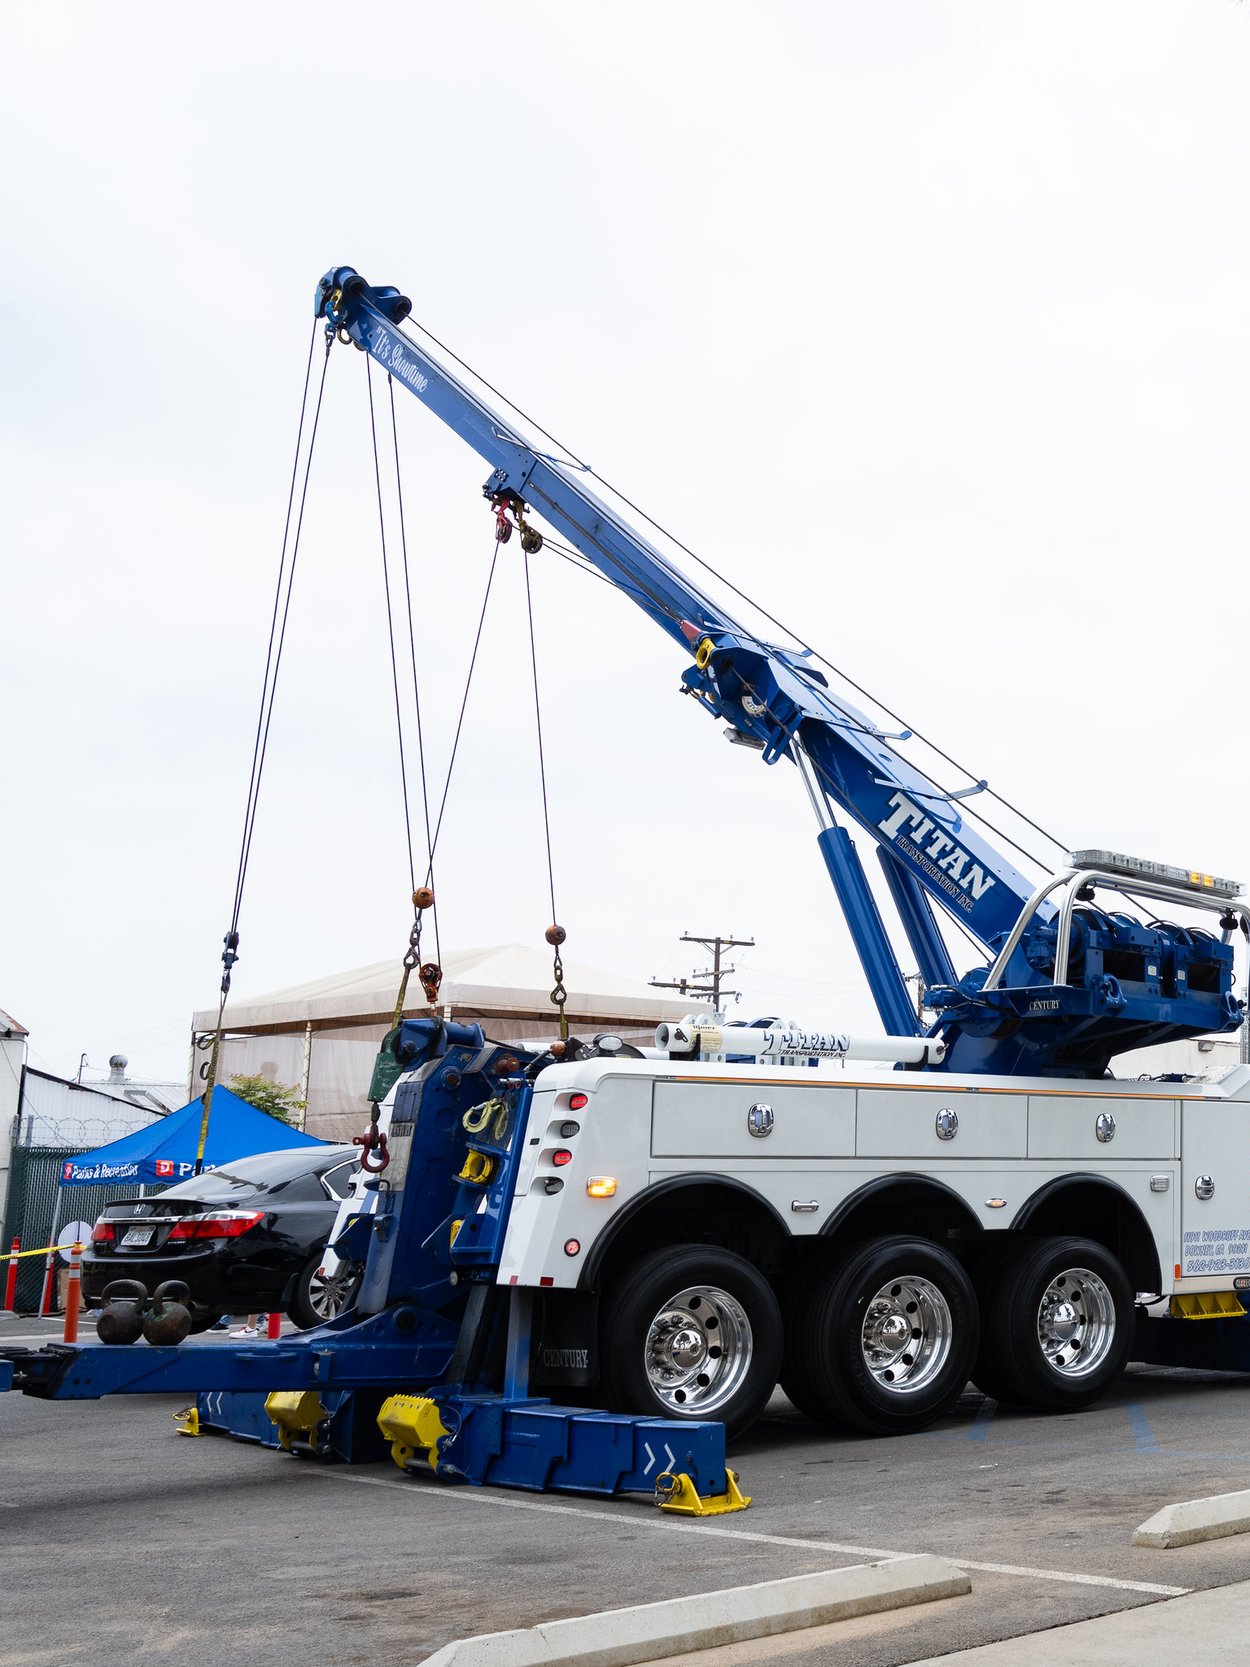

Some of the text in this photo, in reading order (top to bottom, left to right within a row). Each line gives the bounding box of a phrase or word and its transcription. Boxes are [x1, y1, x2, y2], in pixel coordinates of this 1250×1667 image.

[877, 791, 996, 901] TITAN
[894, 834, 975, 914] TRANSPORTATION INC.
[1029, 999, 1061, 1011] CENTURY
[761, 1030, 852, 1056] TITAN
[1202, 1229, 1240, 1243] WOODRUFF
[1186, 1257, 1250, 1273] 562-923-3136
[543, 1348, 589, 1369] CENTURY
